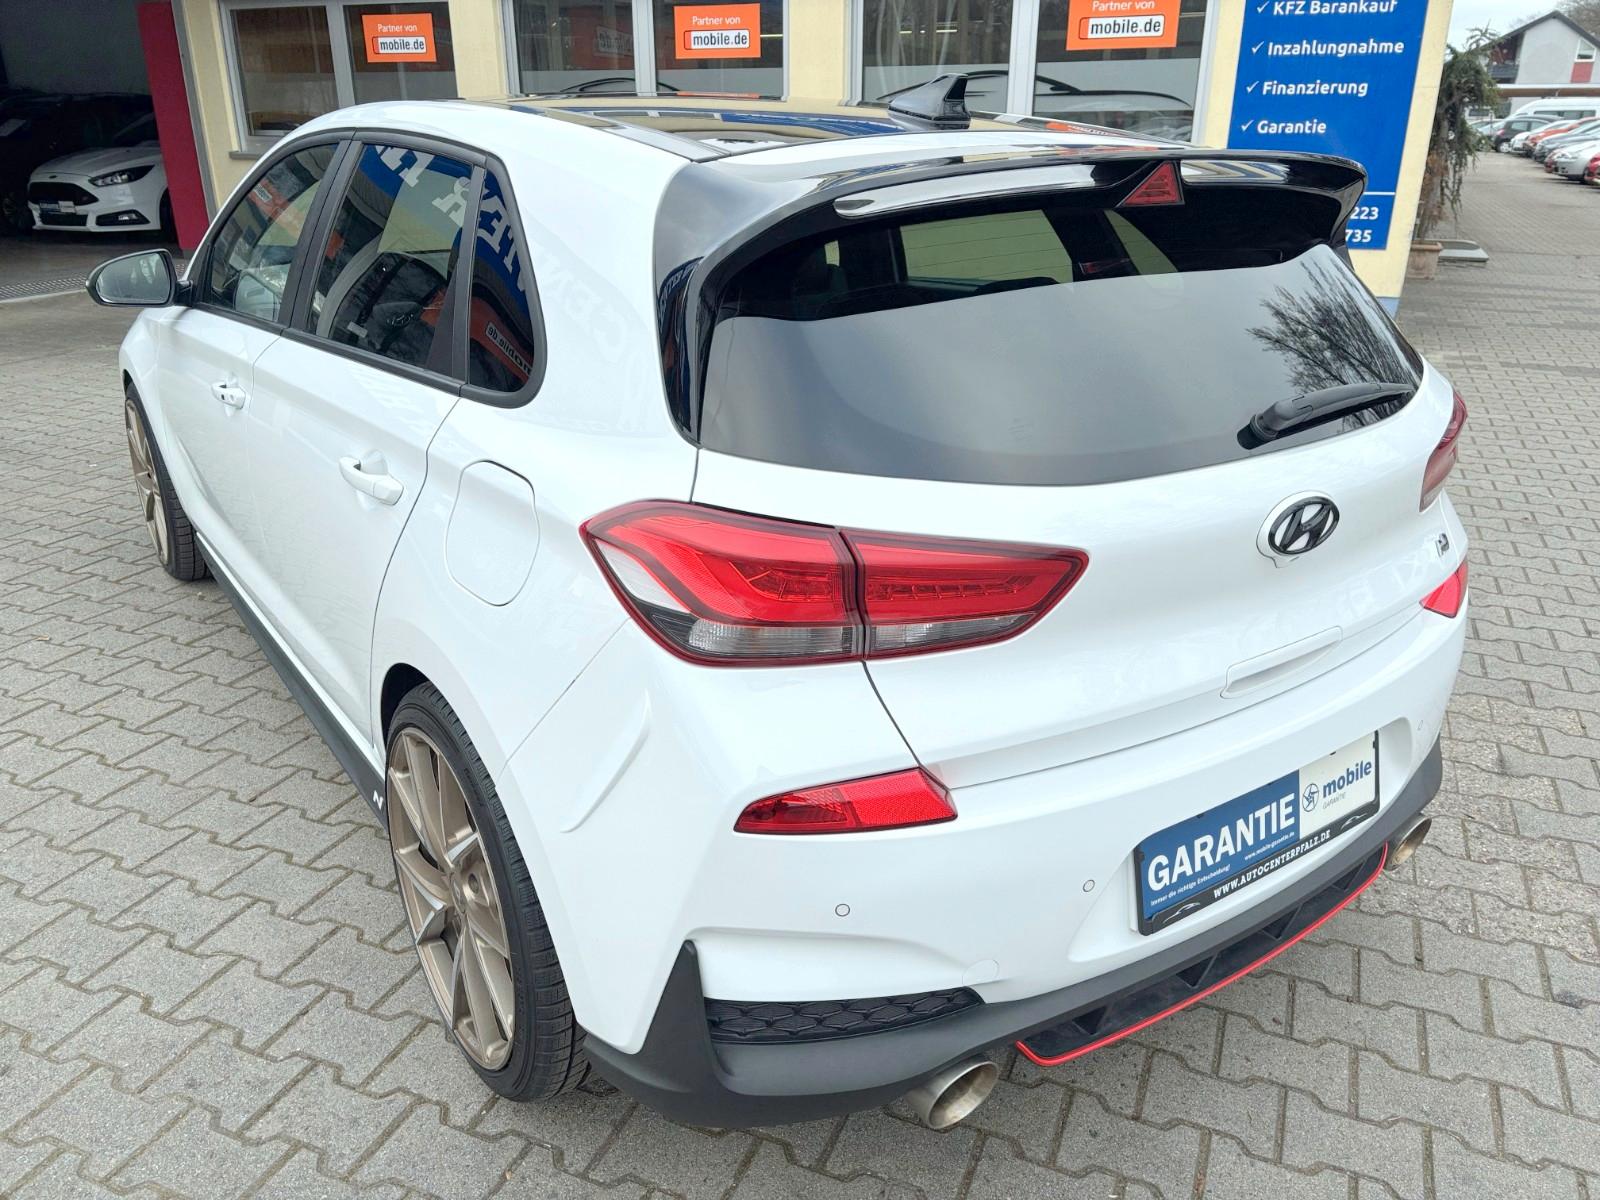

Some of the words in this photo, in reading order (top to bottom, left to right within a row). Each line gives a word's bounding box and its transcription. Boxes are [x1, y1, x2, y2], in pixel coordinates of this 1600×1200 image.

[1092, 0, 1132, 11] Partner
[1135, 0, 1155, 9] von
[1273, 1, 1305, 15] KFZ
[1309, 0, 1398, 14] Barankauf
[377, 24, 403, 32] Partner
[692, 16, 723, 25] Partner
[725, 16, 741, 25] von
[1090, 18, 1161, 34] mobile.de
[380, 38, 425, 51] mobile.de
[693, 32, 748, 46] mobile.de
[1267, 38, 1405, 57] Inzahlungnahme
[1262, 80, 1369, 97] Finanzierung
[1257, 119, 1327, 134] Garantie
[1322, 760, 1372, 798] mobile
[1148, 792, 1295, 891] GARANTIE
[1213, 829, 1331, 899] WWW.AUTOCENTERPFALZ.DE
